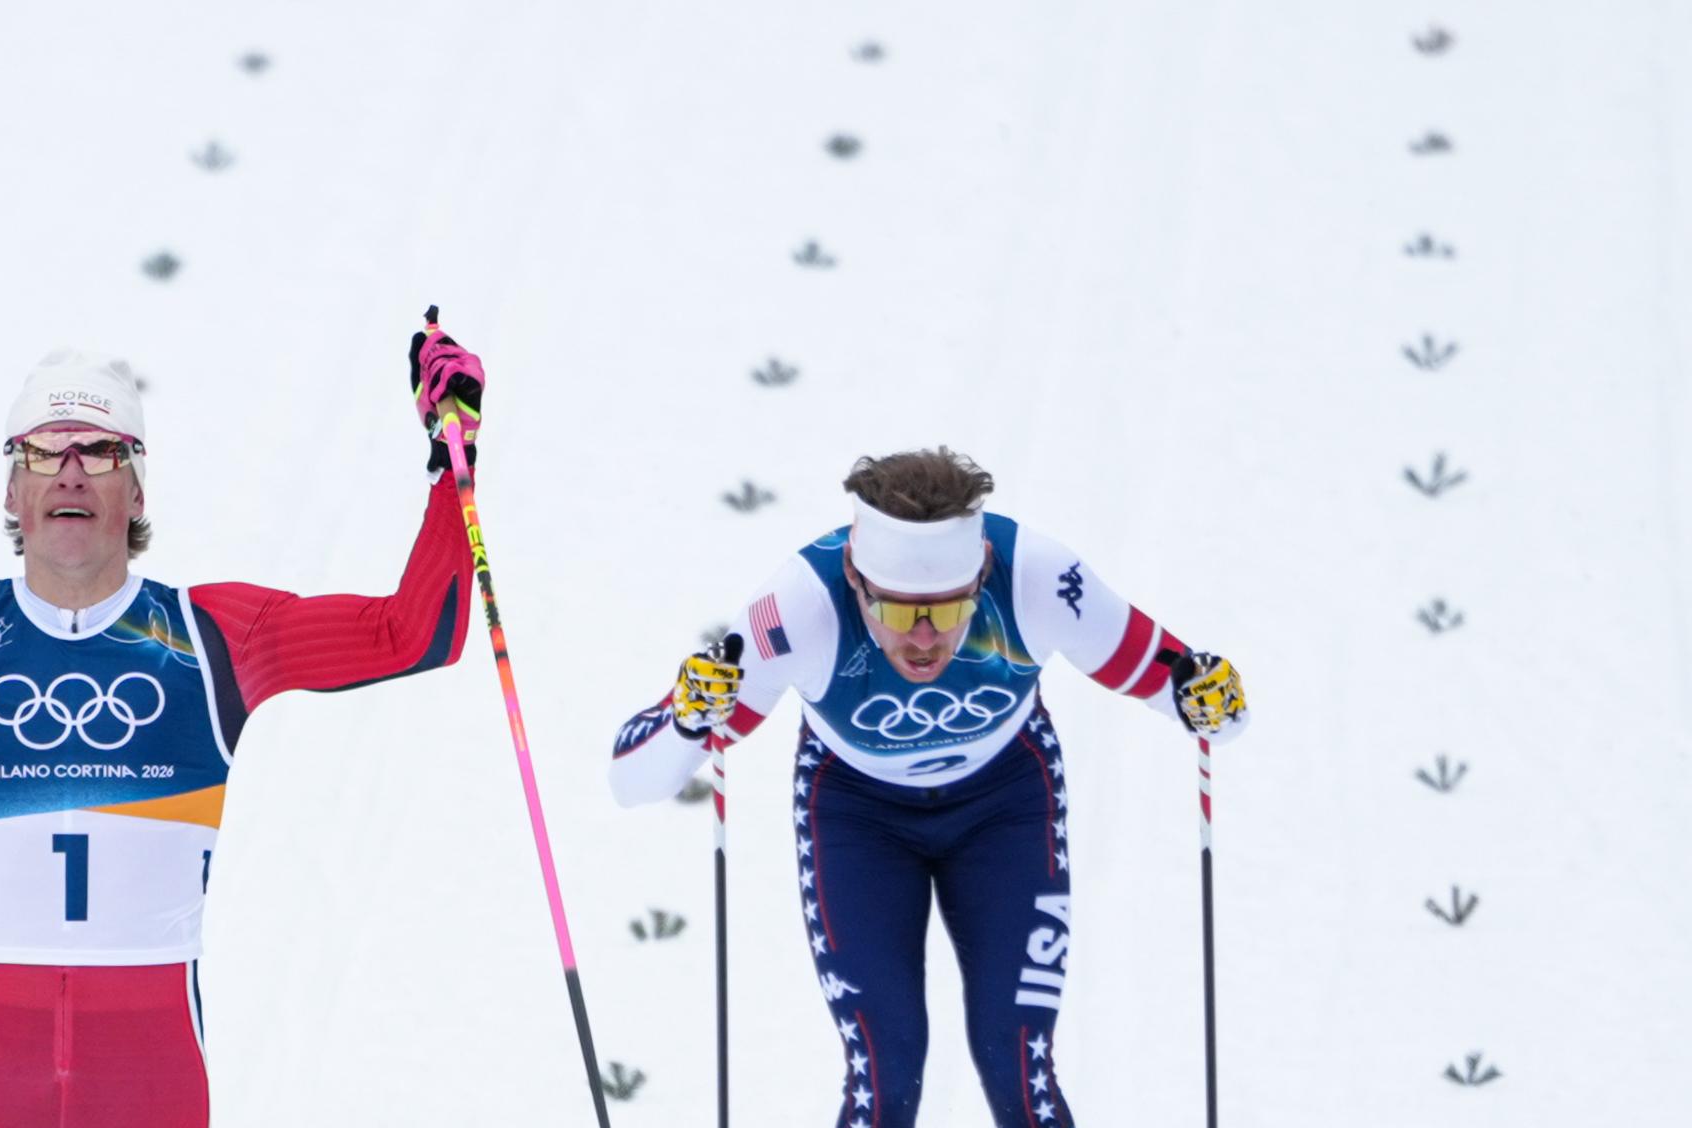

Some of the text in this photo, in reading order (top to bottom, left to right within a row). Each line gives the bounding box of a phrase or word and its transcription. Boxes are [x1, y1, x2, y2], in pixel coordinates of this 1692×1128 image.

[48, 391, 113, 409] NORGE
[461, 504, 491, 573] LEKI
[53, 764, 138, 778] CORTINA
[141, 764, 175, 778] 2026
[52, 833, 89, 921] 1
[1014, 894, 1071, 1010] USA
